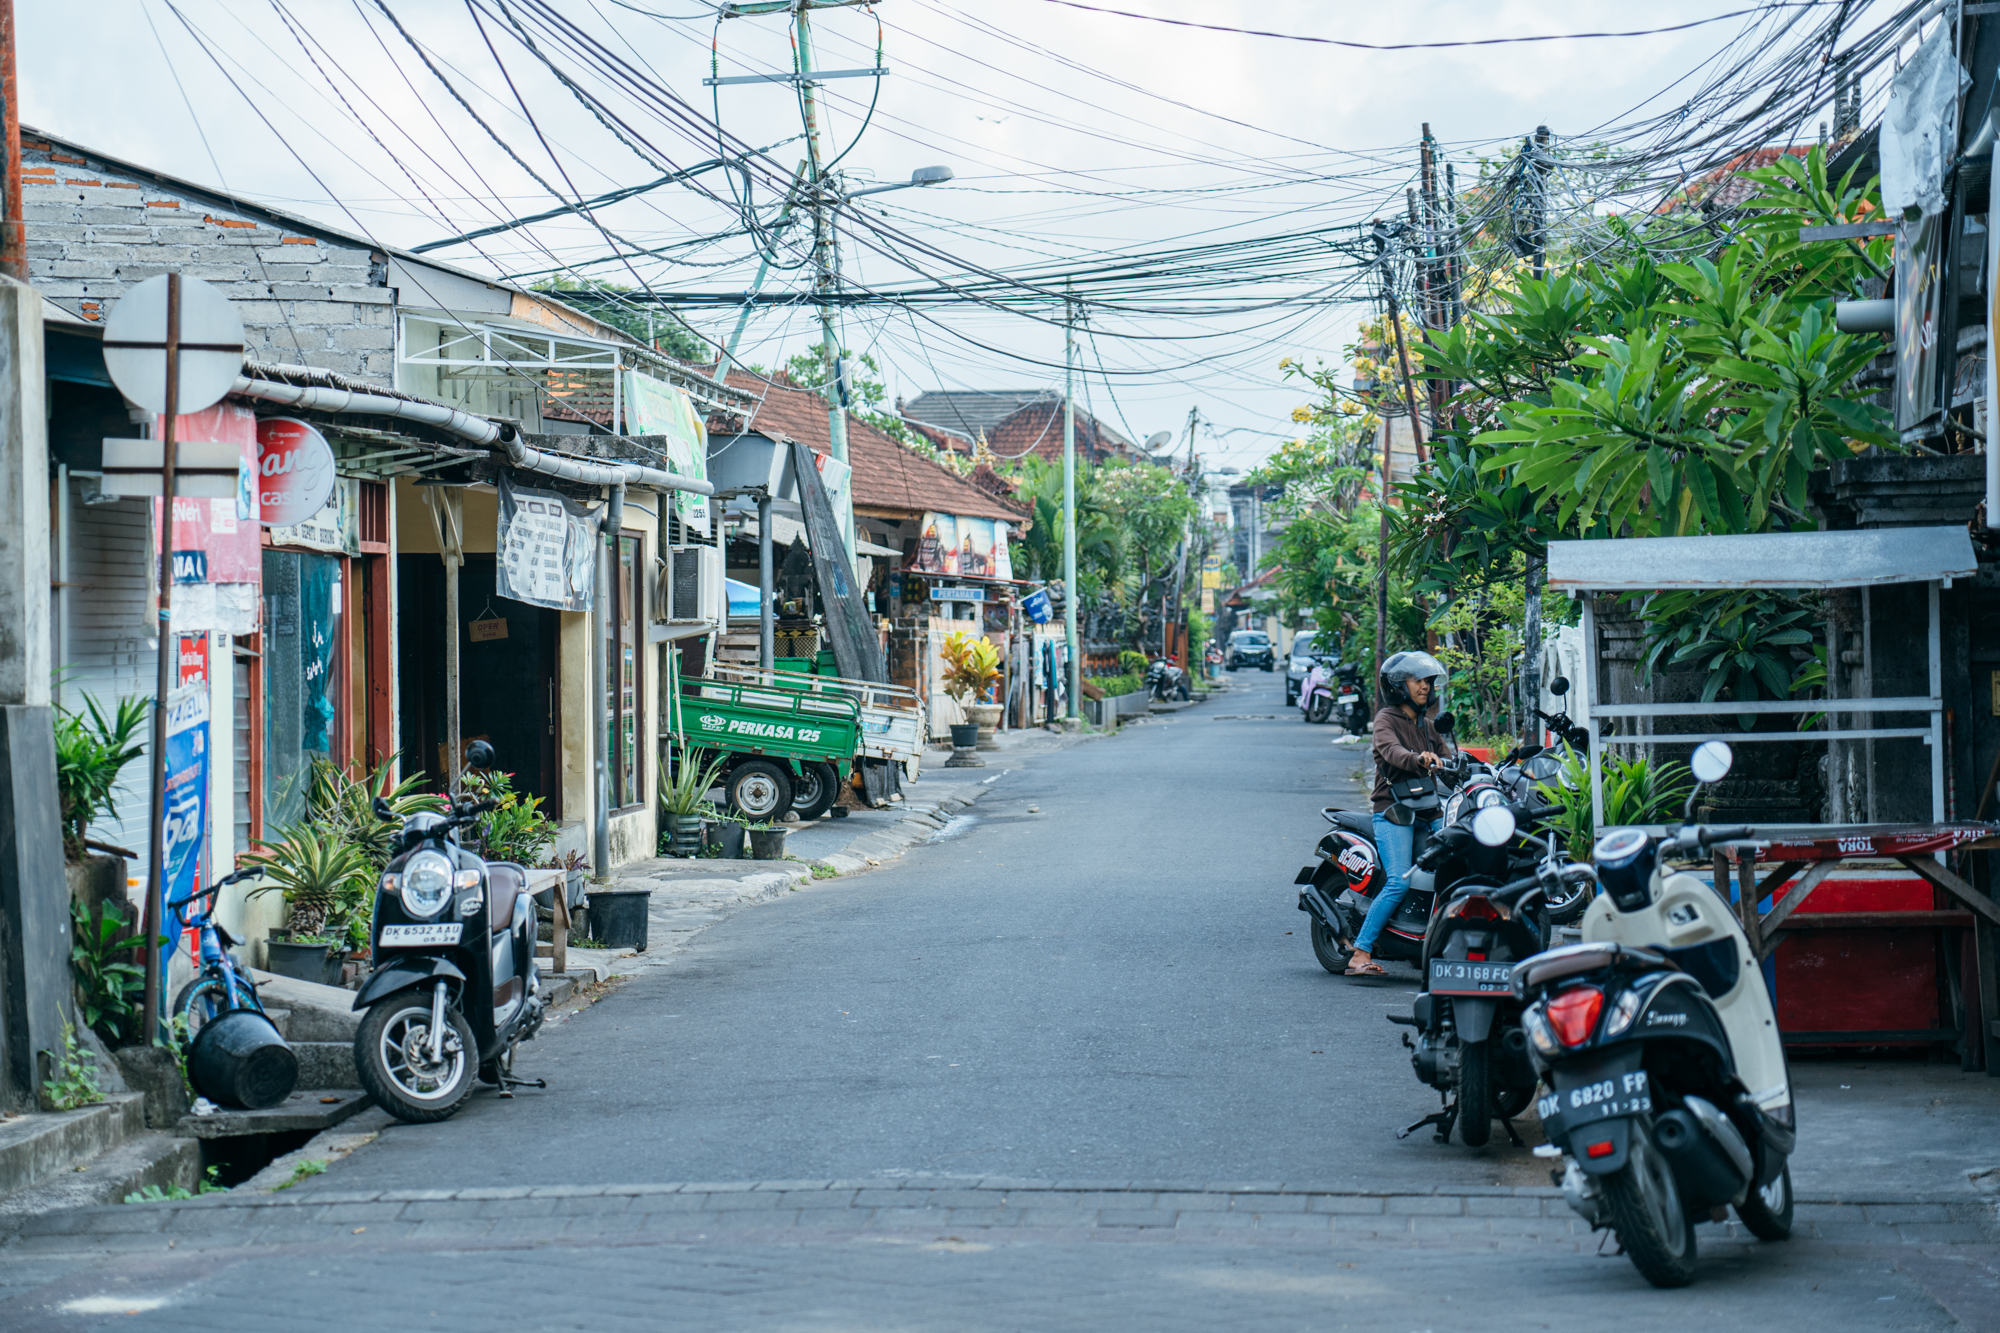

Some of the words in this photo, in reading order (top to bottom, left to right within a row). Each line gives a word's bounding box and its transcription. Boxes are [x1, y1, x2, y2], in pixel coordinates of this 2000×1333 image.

[937, 589, 975, 599] PERTAMAX
[477, 622, 499, 631] OPEN
[727, 719, 794, 740] PERKASA
[797, 728, 821, 742] 125
[1838, 840, 1875, 853] TORA
[1338, 848, 1375, 876] SCOOPY
[385, 927, 400, 936] DK
[404, 926, 433, 935] 6532
[436, 925, 460, 934] AAU
[1435, 964, 1452, 978] DK
[1455, 965, 1490, 980] 3168
[1492, 968, 1510, 980] FC
[1537, 1094, 1560, 1120] DK
[1570, 1079, 1615, 1109] 6820
[1622, 1070, 1647, 1094] FP
